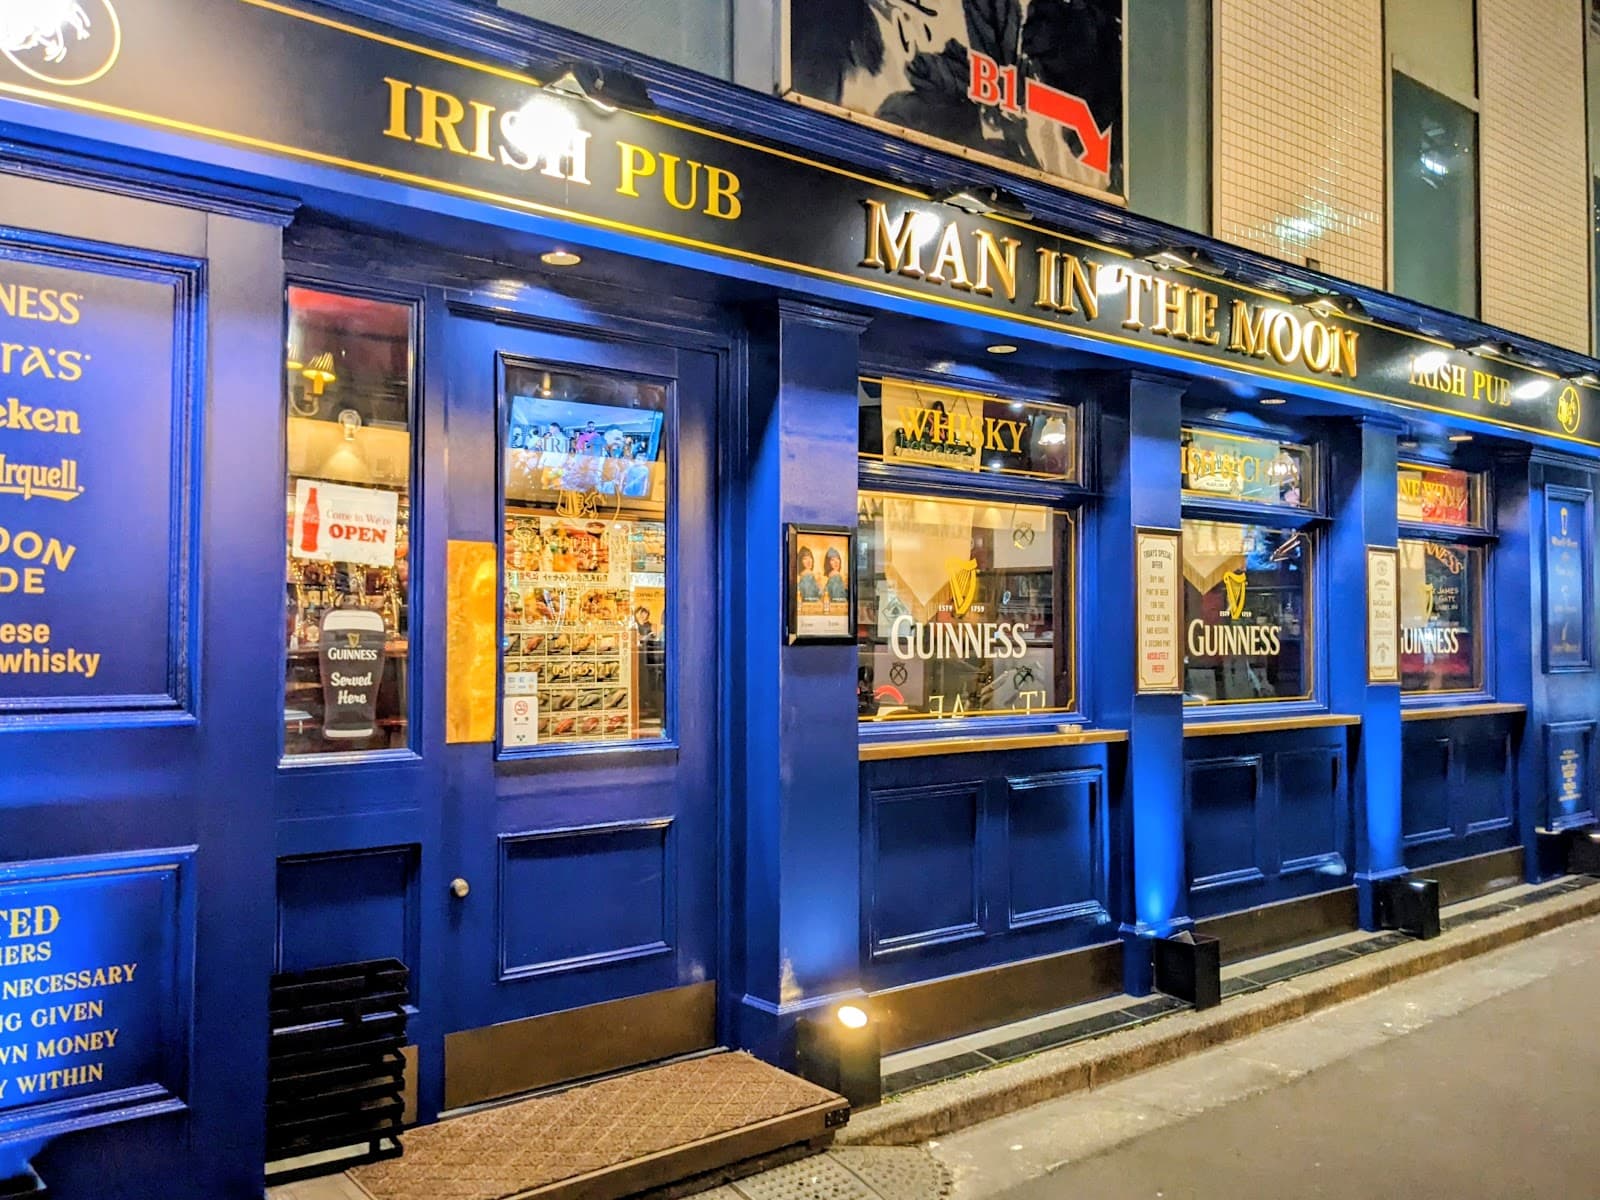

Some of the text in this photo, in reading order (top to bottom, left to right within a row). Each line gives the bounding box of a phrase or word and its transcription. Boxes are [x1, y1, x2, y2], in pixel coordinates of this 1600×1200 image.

[969, 51, 1020, 112] B1
[383, 77, 742, 220] IRISH PUB
[0, 284, 82, 325] NESS
[860, 198, 1360, 378] MAN IN THE MOON
[1408, 354, 1512, 407] IRISH PUB
[897, 406, 1027, 453] WHISKY
[329, 523, 388, 544] OPEN
[0, 622, 50, 644] ese
[891, 614, 1026, 660] GUINNESS
[1187, 618, 1281, 657] GUINNESS
[0, 648, 101, 678] whisky
[327, 647, 378, 661] GUINNESS
[331, 671, 373, 687] Served
[337, 689, 368, 705] Here
[3, 963, 138, 1000] NECESSARY
[30, 999, 104, 1028] GIVEN
[36, 1028, 119, 1060] MONEY
[17, 1062, 104, 1095] WITHIN
